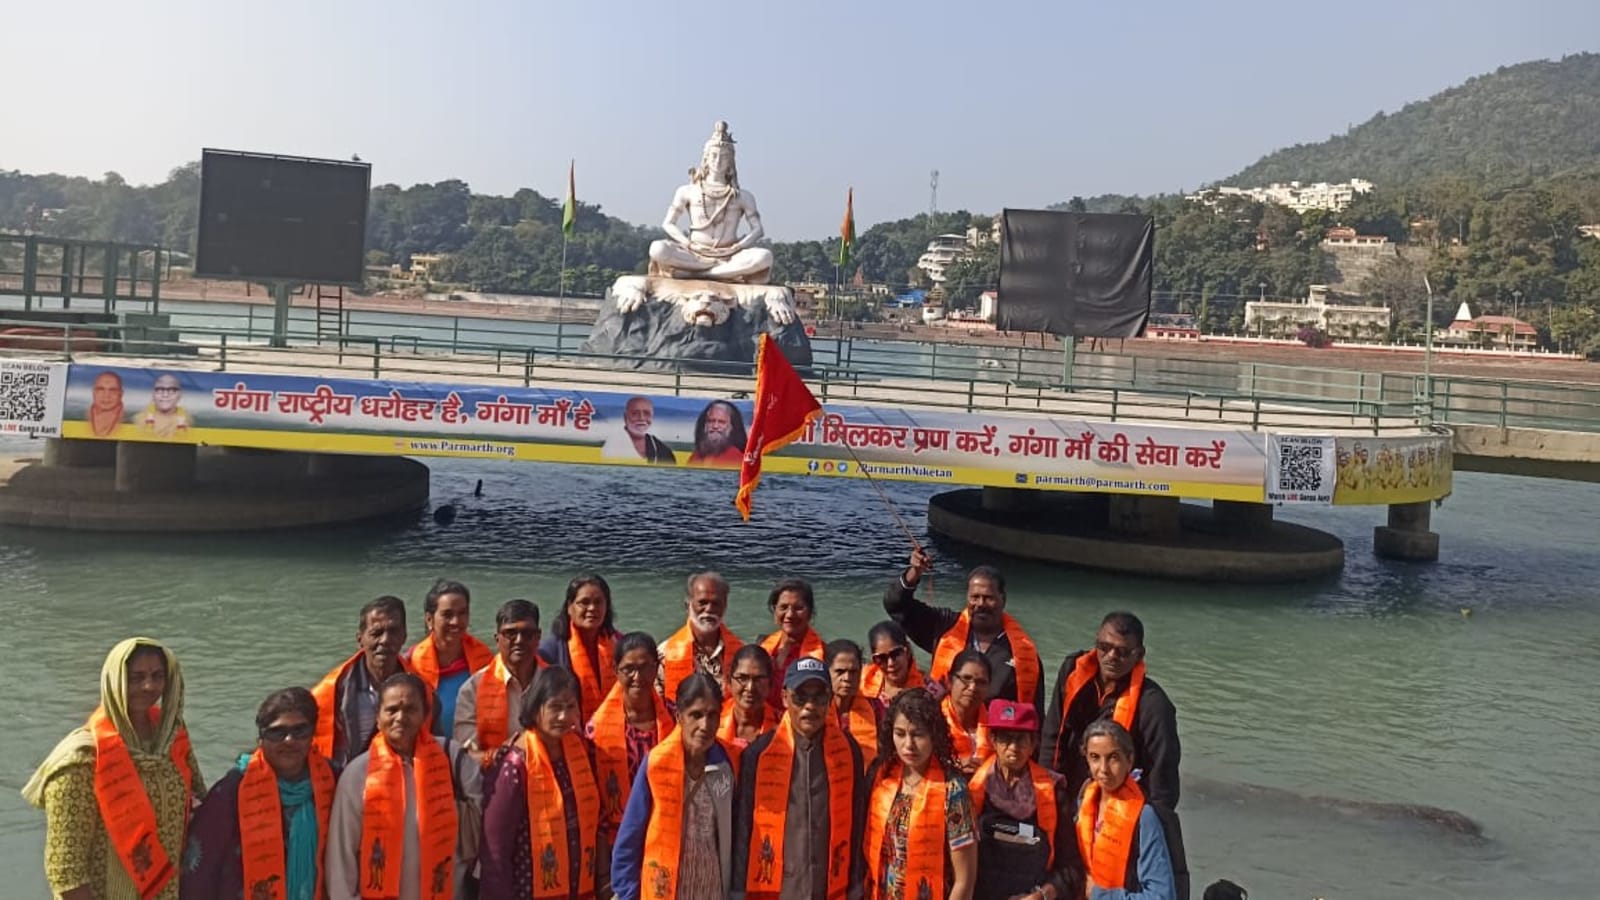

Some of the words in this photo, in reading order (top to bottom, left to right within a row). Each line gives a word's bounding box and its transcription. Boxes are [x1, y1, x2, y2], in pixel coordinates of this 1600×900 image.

[215, 384, 271, 412] गंगा
[278, 386, 354, 424] राष्ट्रीय
[361, 391, 436, 421] धरोहर
[441, 392, 468, 425] है,
[478, 396, 531, 425] गंगा
[538, 400, 570, 426] माँ
[574, 401, 594, 430] है
[3, 424, 17, 432] LIVE
[410, 441, 515, 456] www.Parmarth.org
[822, 414, 909, 448] मिलकर
[913, 428, 951, 453] प्रण
[955, 425, 1000, 456] करें,
[1009, 428, 1059, 458] गंगा
[1064, 431, 1095, 460] माँ
[1098, 433, 1130, 463] की
[1135, 436, 1179, 466] सेवा
[1185, 440, 1226, 468] करें
[1035, 475, 1170, 491] parmarth@parmarth.com
